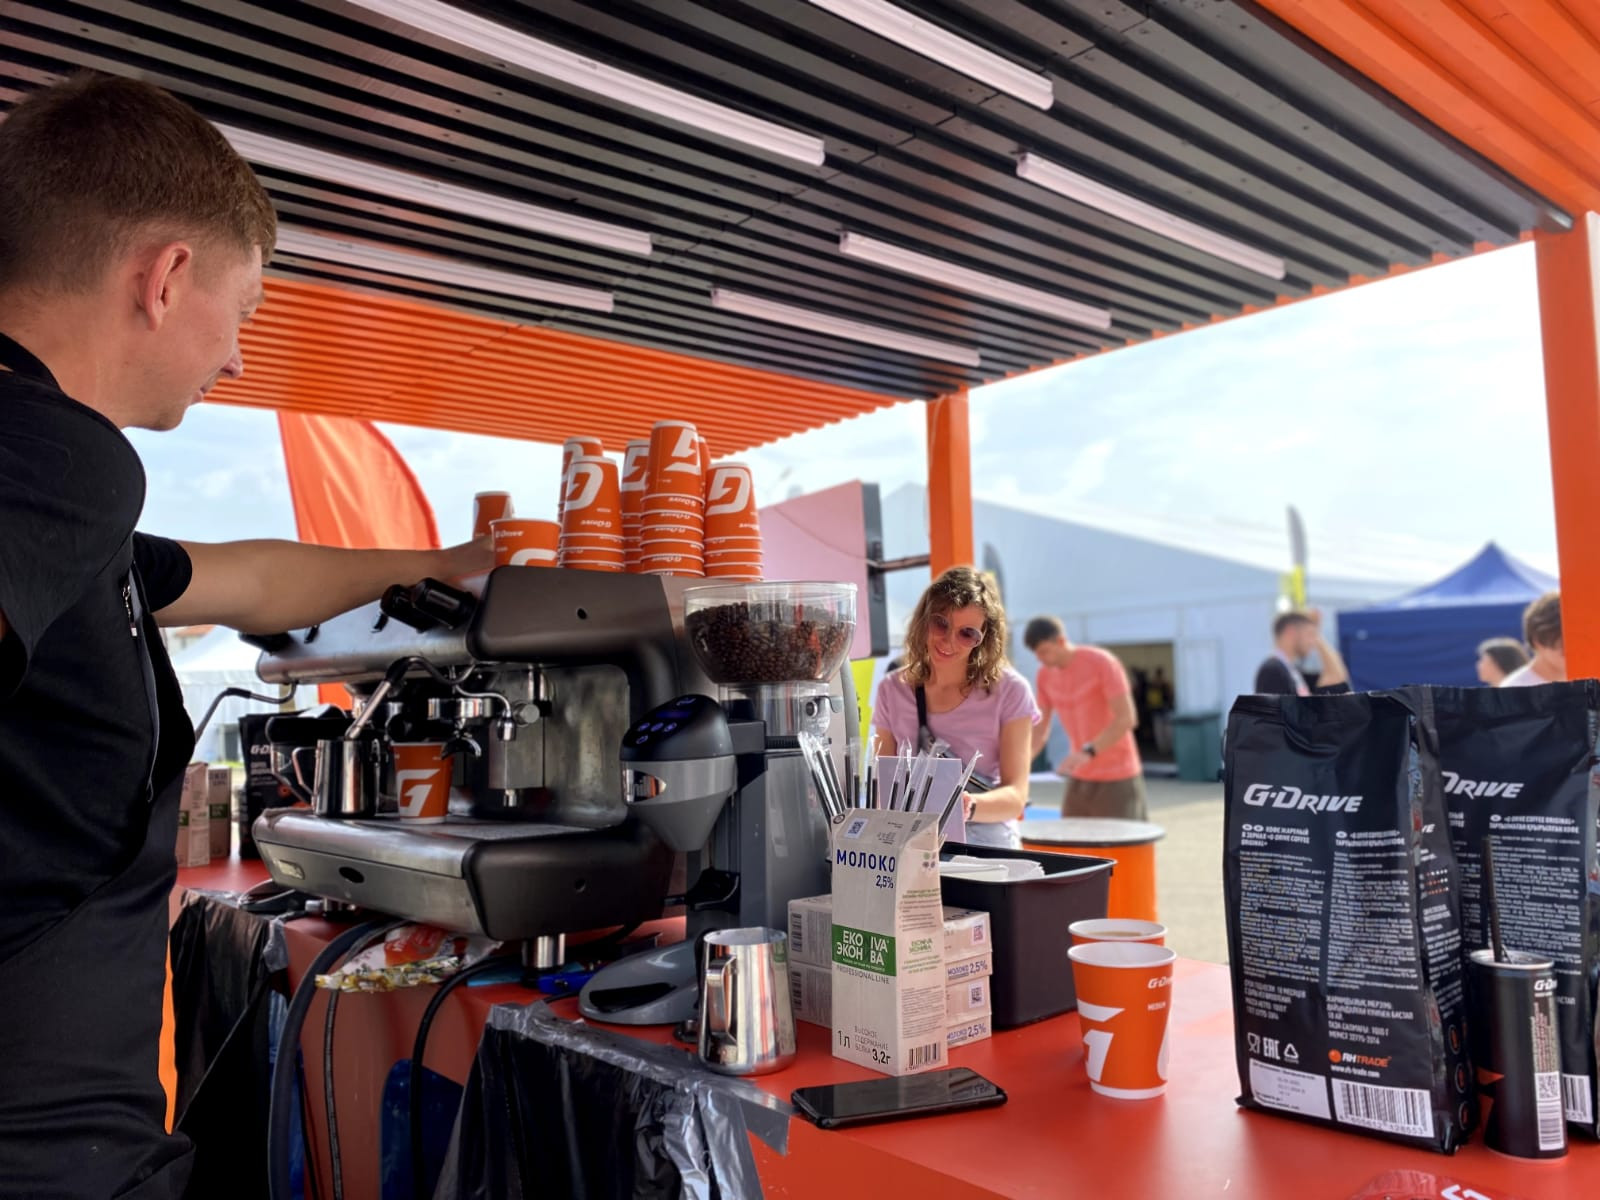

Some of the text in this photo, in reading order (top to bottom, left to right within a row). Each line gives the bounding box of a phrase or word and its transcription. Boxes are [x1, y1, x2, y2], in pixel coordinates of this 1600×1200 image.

[836, 848, 896, 873] МОЛОКО
[875, 874, 894, 889] 2,5%
[947, 965, 969, 976] МОЛОКО
[969, 960, 988, 974] 2,5%
[967, 1023, 987, 1037] 2,5%
[872, 1048, 891, 1065] 3,2г
